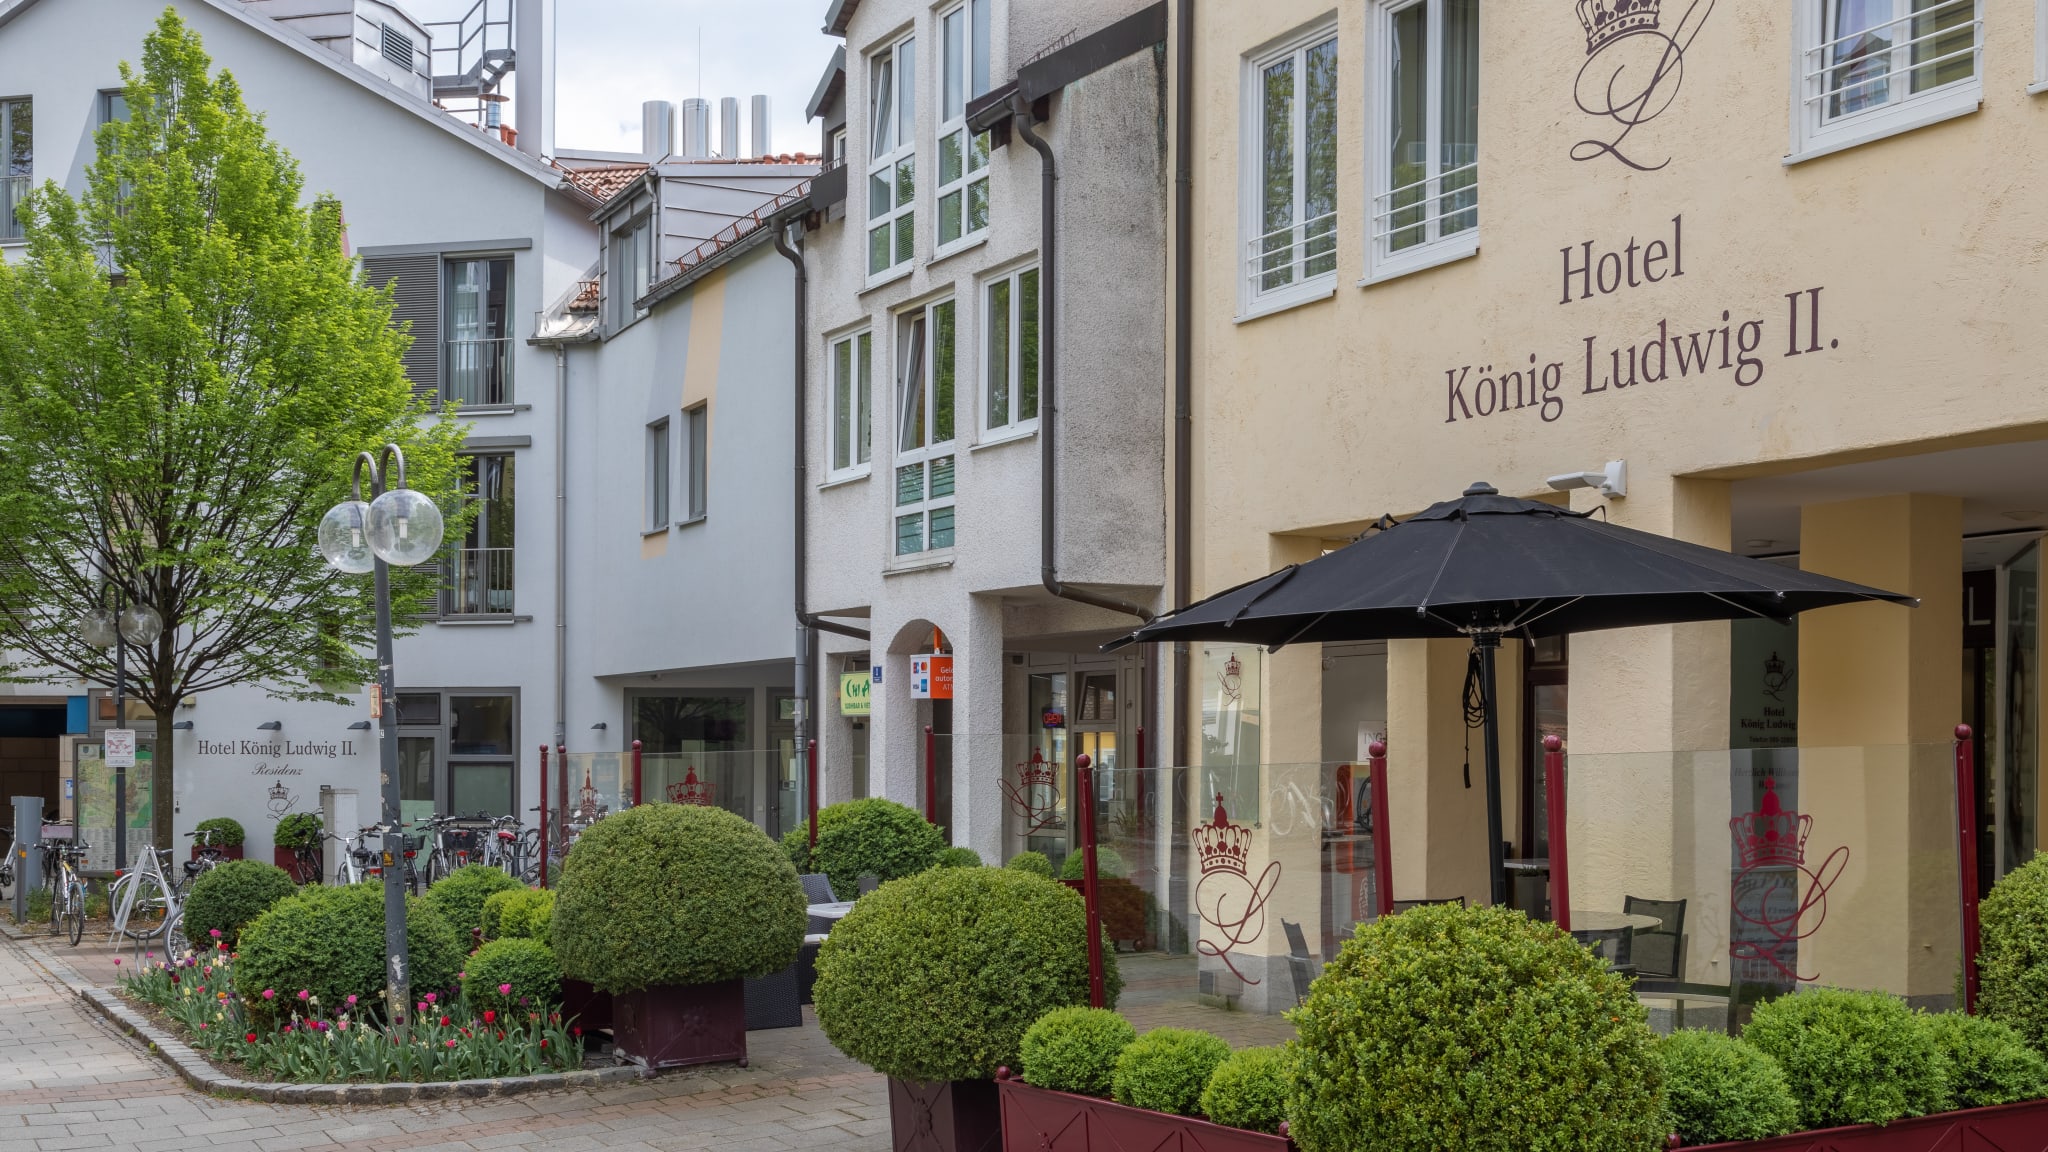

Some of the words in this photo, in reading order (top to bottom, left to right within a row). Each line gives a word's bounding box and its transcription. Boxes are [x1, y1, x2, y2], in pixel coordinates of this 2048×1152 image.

[1559, 213, 1685, 305] Hotel
[1445, 353, 1564, 423] König
[1582, 309, 1764, 395] Ludwig
[1783, 286, 1839, 357] II.
[1763, 706, 1785, 717] Hotel
[1741, 718, 1765, 731] König
[1766, 718, 1797, 731] Ludwig
[198, 740, 235, 756] Hotel
[240, 740, 282, 759] König
[286, 740, 337, 759] Ludwig
[341, 740, 357, 756] II.
[251, 762, 304, 776] Residenz
